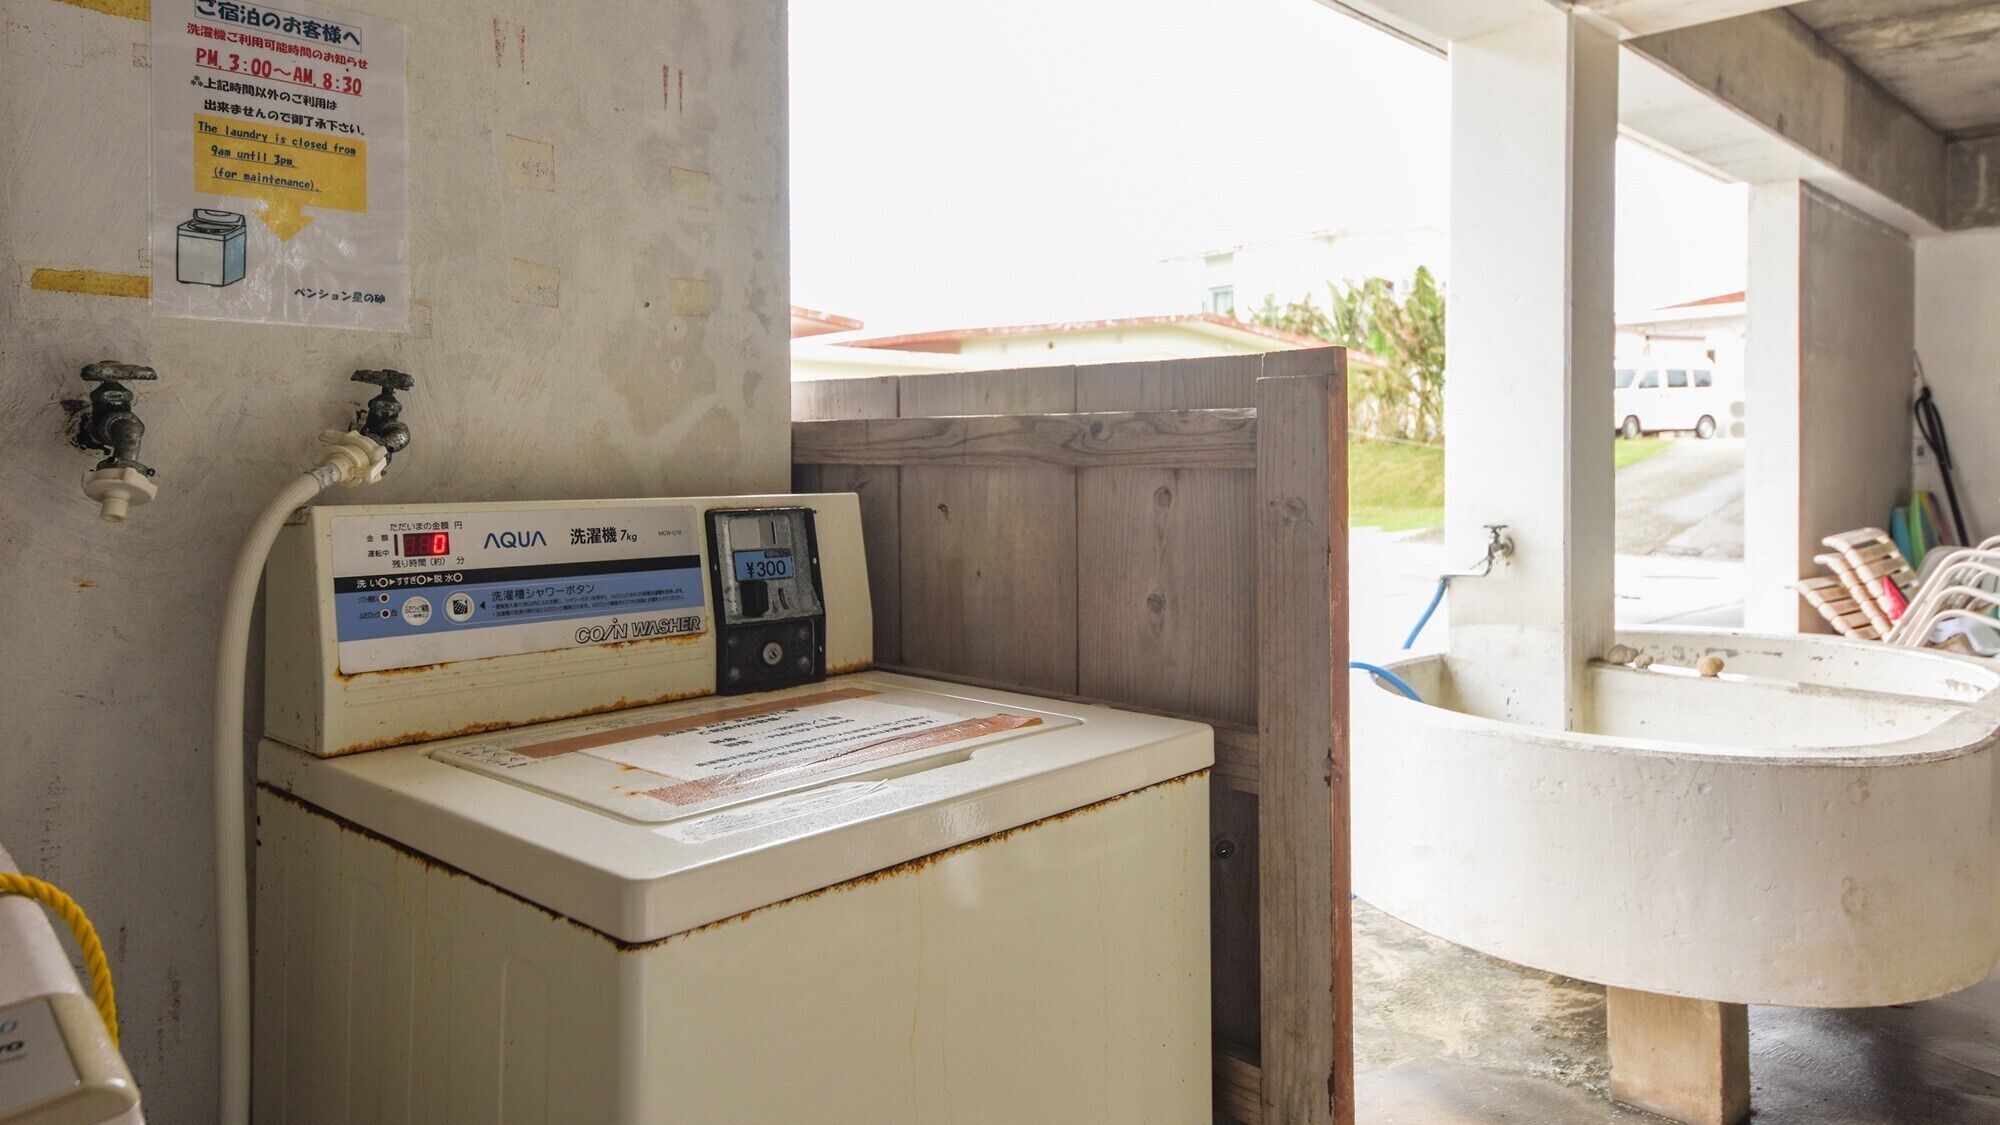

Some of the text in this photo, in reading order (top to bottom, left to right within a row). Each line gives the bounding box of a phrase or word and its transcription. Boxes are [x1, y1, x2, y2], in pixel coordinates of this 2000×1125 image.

[196, 0, 361, 46] ご宿泊のお客様へ
[187, 23, 368, 70] 洗濯機ご利用可能時間のお知らせ
[204, 99, 365, 136] 出来ませんので御了承下さい。
[198, 121, 356, 155] The laundry is closed from
[211, 144, 231, 157] 9am
[237, 151, 267, 162] until
[214, 166, 319, 192] (for maintenance).
[390, 520, 463, 532] ただいまの金額 円
[570, 527, 638, 545] 洗濯機 7kg
[433, 533, 447, 554] 0
[484, 531, 547, 549] AQUA
[456, 556, 465, 565] 分
[746, 559, 786, 578] ¥300
[492, 584, 595, 602] 洗濯槽シャワーボタン
[575, 616, 701, 644] COIN WASHER
